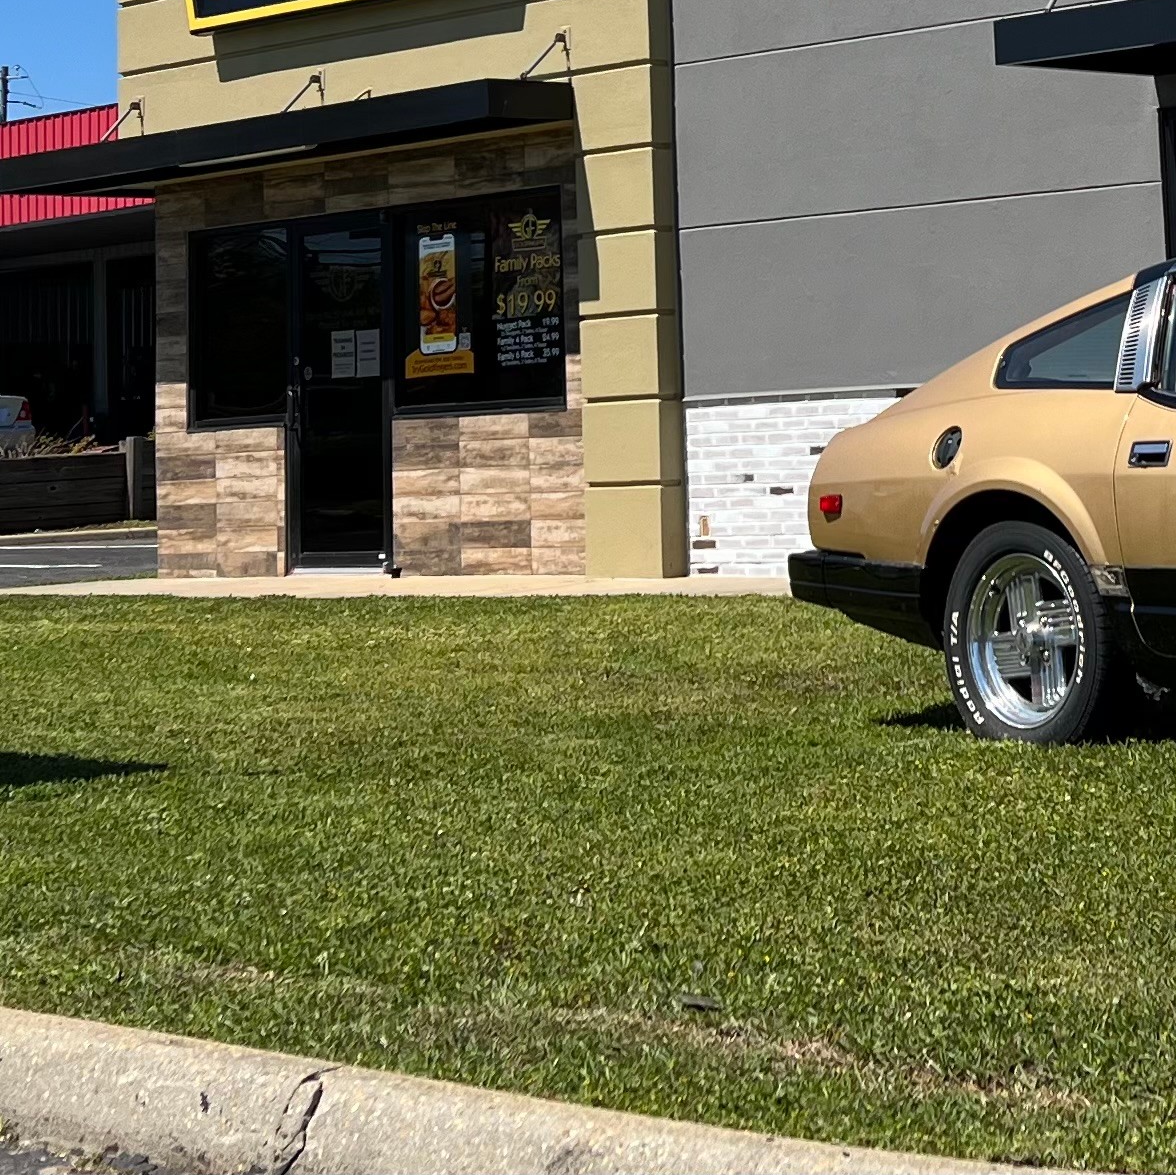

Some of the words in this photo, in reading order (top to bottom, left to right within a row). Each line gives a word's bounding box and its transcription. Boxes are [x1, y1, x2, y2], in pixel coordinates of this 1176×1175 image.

[494, 254, 528, 273] Family
[530, 252, 560, 269] Packs
[496, 289, 557, 316] $19.99
